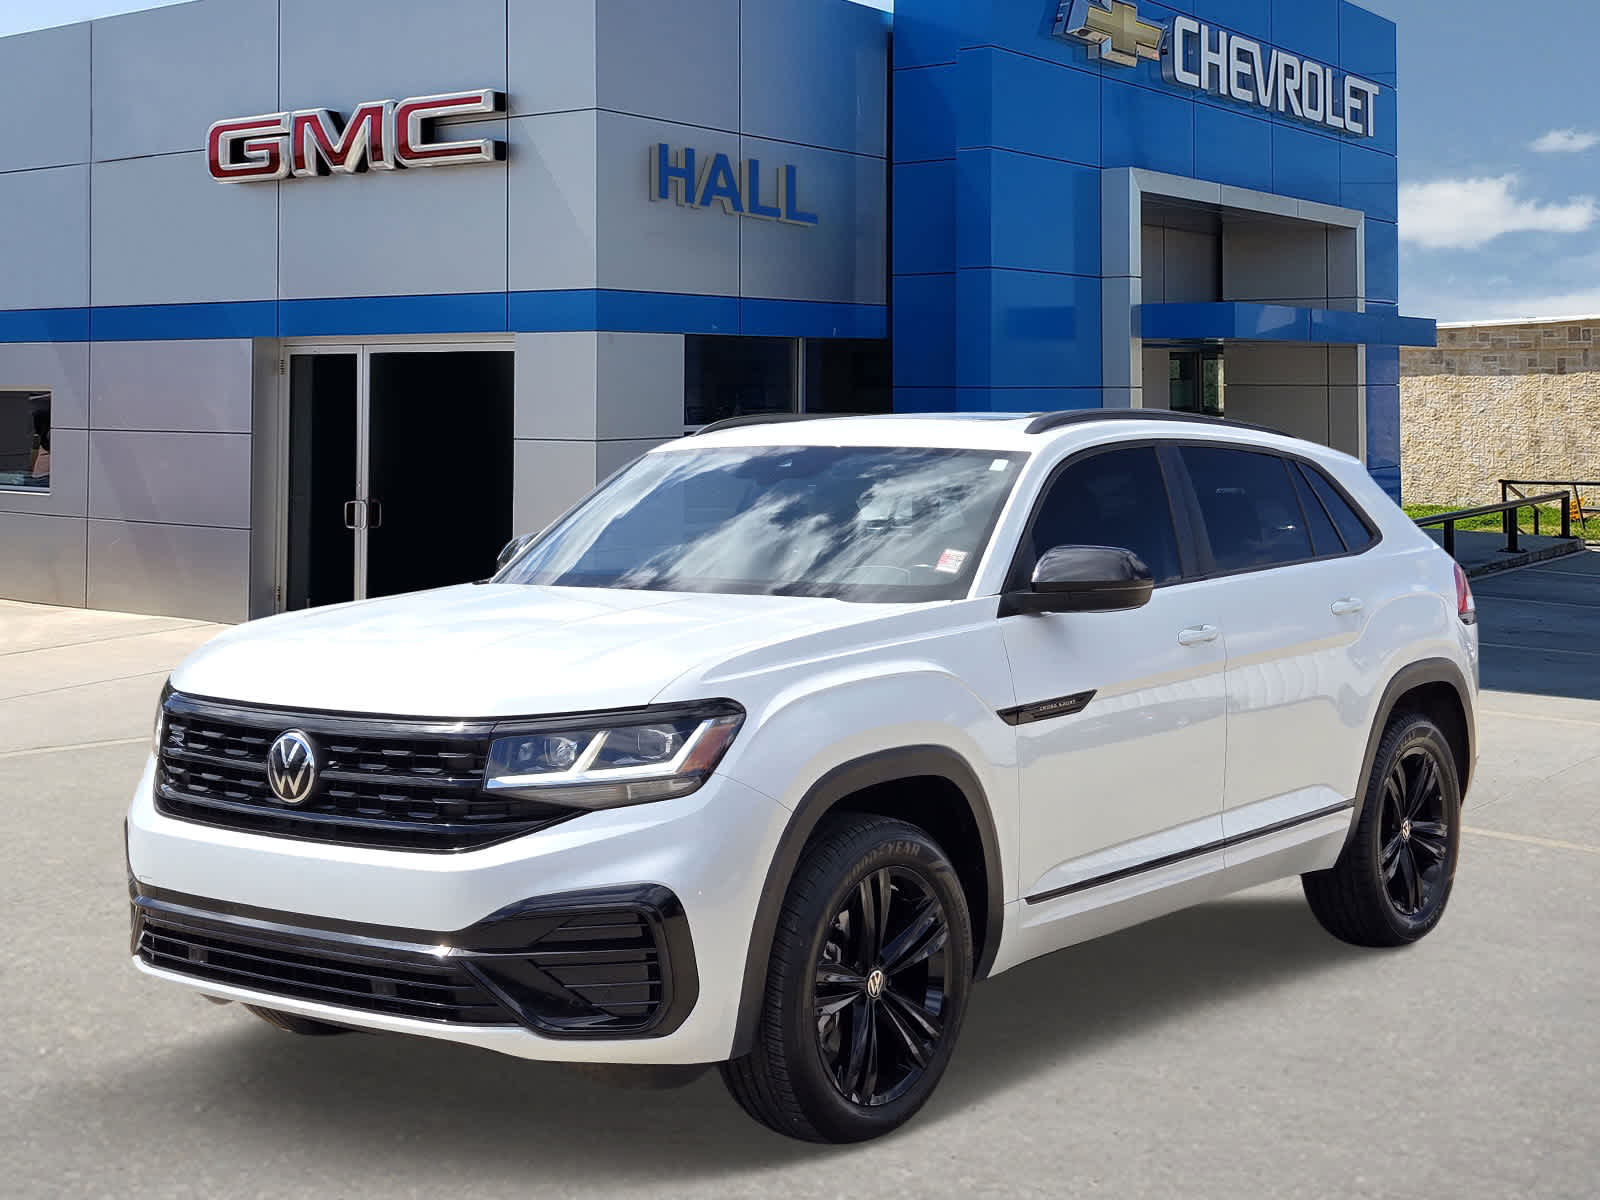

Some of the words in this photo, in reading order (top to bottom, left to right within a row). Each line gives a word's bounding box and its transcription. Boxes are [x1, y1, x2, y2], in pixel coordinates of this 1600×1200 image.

[1174, 15, 1379, 137] CHEVROLET
[208, 88, 506, 184] GMC
[652, 143, 819, 225] HALL
[268, 729, 315, 803] VW
